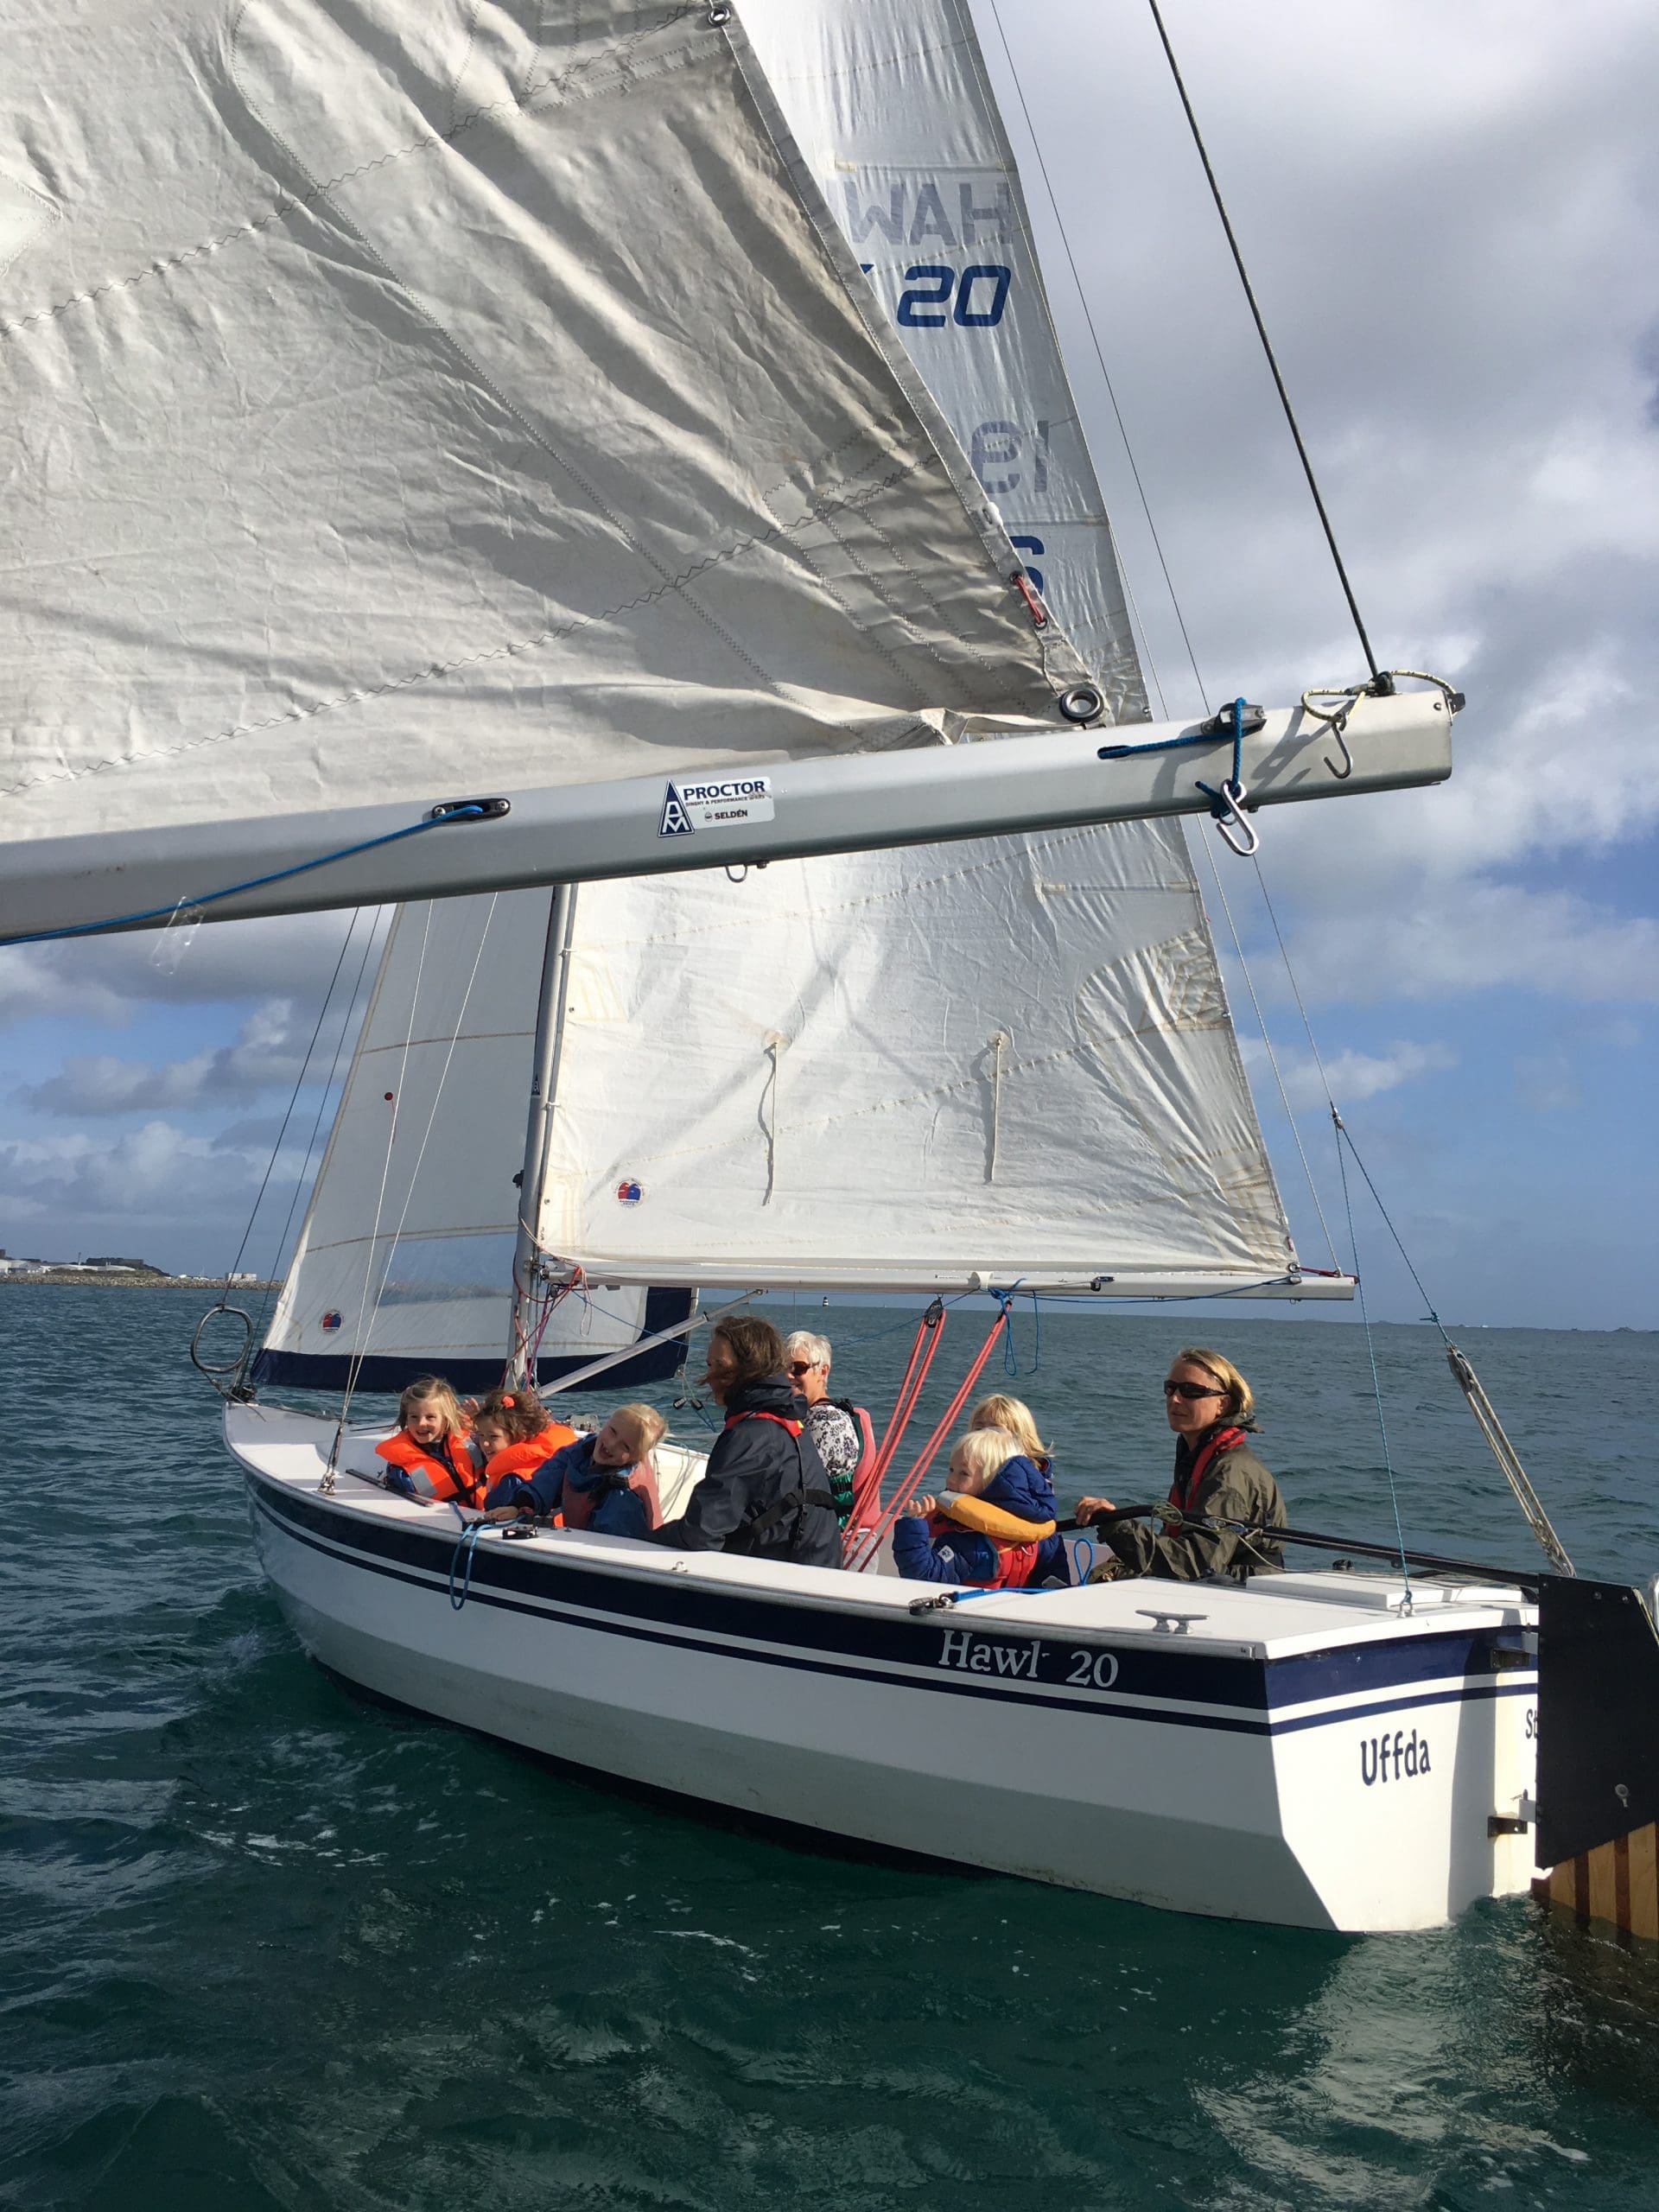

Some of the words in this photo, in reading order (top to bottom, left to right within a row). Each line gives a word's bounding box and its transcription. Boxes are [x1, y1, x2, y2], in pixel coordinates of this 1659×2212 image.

[897, 265, 1012, 327] 20
[683, 781, 766, 800] PROCTOR
[715, 809, 748, 819] SELDÉN
[1065, 1650, 1119, 1688] 20
[1360, 1728, 1431, 1786] Uffda
